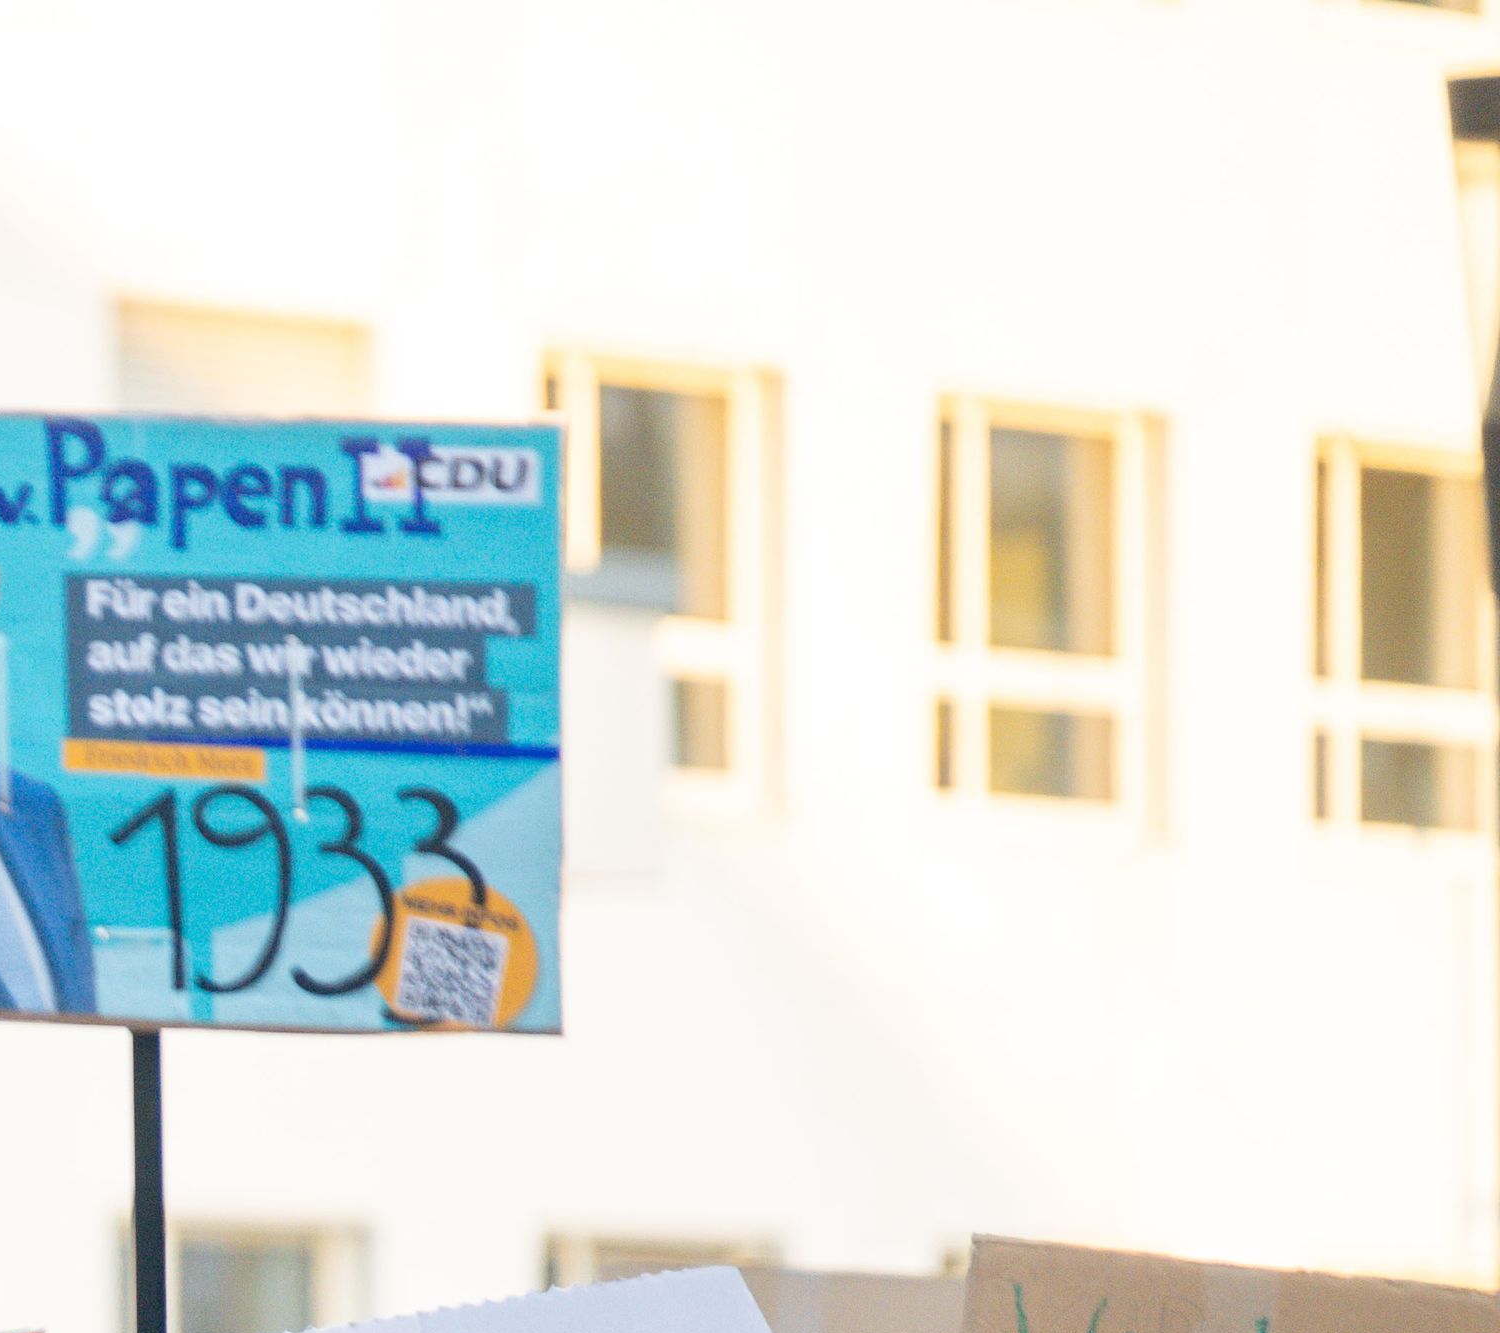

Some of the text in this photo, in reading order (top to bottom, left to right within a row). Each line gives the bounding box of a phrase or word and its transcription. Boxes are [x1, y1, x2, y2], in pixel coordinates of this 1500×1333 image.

[45, 419, 330, 548] Papen
[85, 579, 520, 637] Für ein Deutschland,
[87, 633, 473, 681] auf das wir wieder
[88, 687, 194, 730] stolz
[200, 689, 290, 731] sein
[108, 782, 490, 1026] 1933
